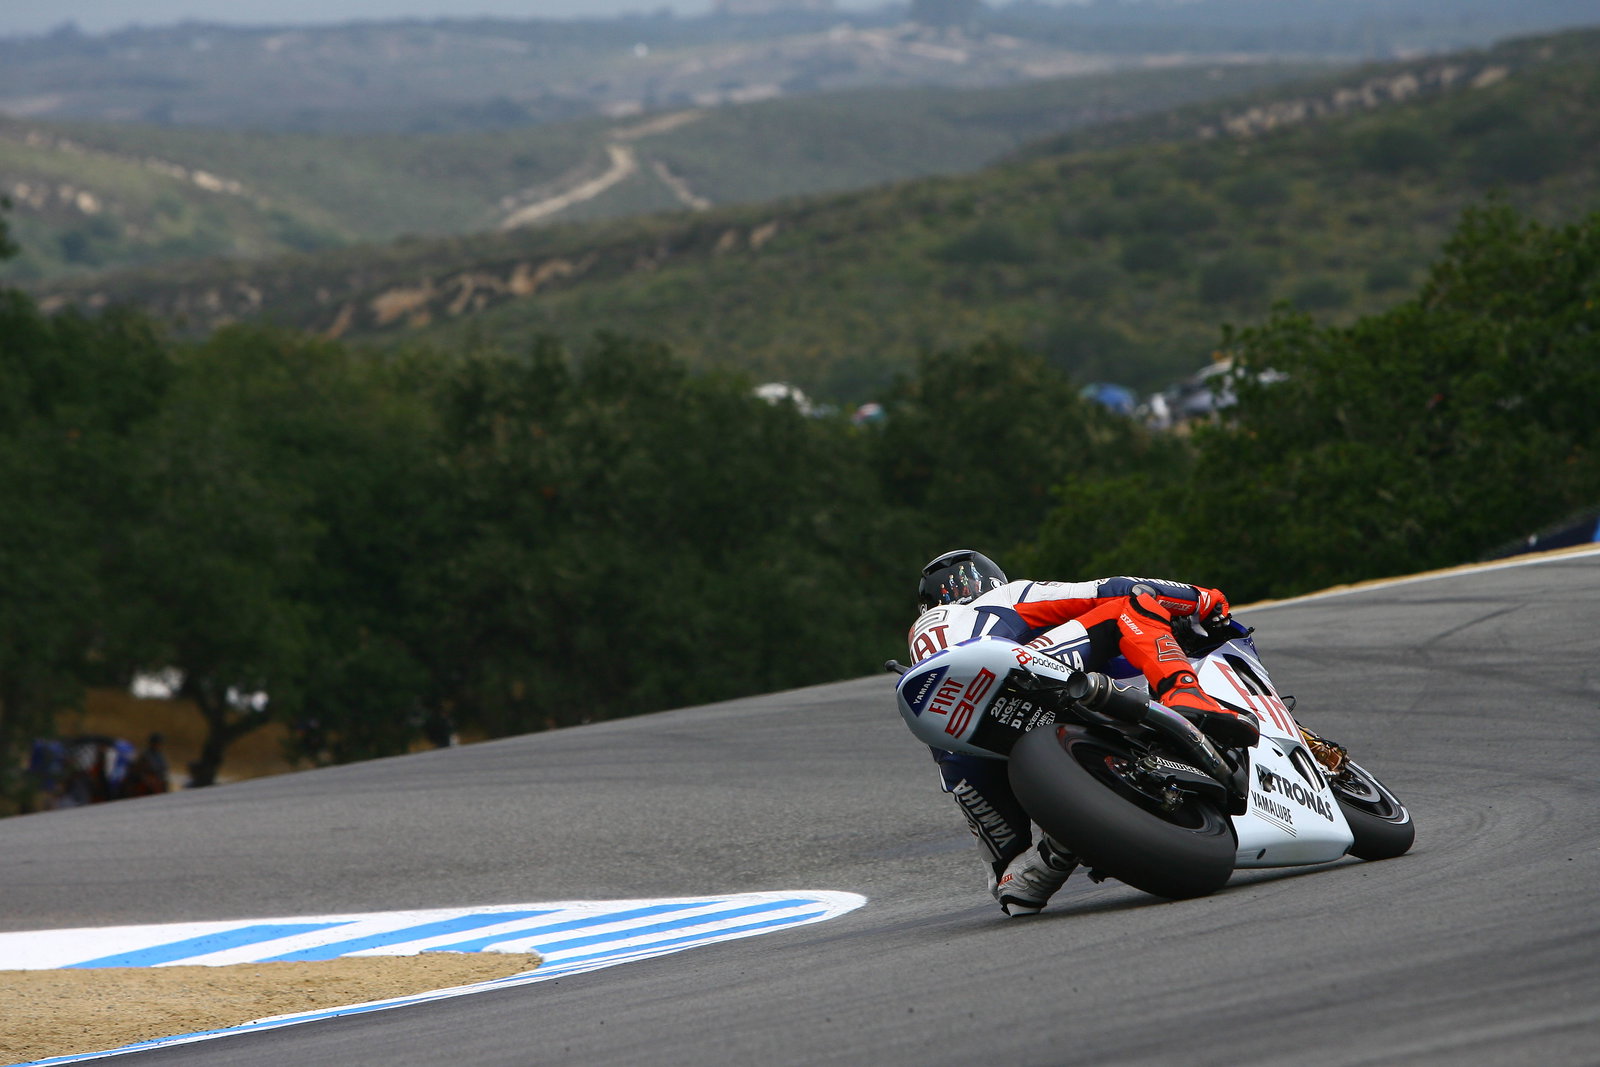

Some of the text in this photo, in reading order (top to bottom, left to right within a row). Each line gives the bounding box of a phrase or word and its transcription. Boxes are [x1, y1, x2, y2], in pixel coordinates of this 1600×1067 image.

[1032, 656, 1065, 673] packard
[913, 672, 938, 705] YAMAHA
[928, 677, 964, 715] FIAT
[944, 667, 996, 739] 99
[991, 697, 1007, 718] 2D
[998, 697, 1019, 724] NGK
[1025, 706, 1042, 732] EXEDY
[1251, 789, 1293, 825] YAMALUBE
[1255, 763, 1334, 822] PTRONAS
[952, 778, 1017, 849] YAMAHA
